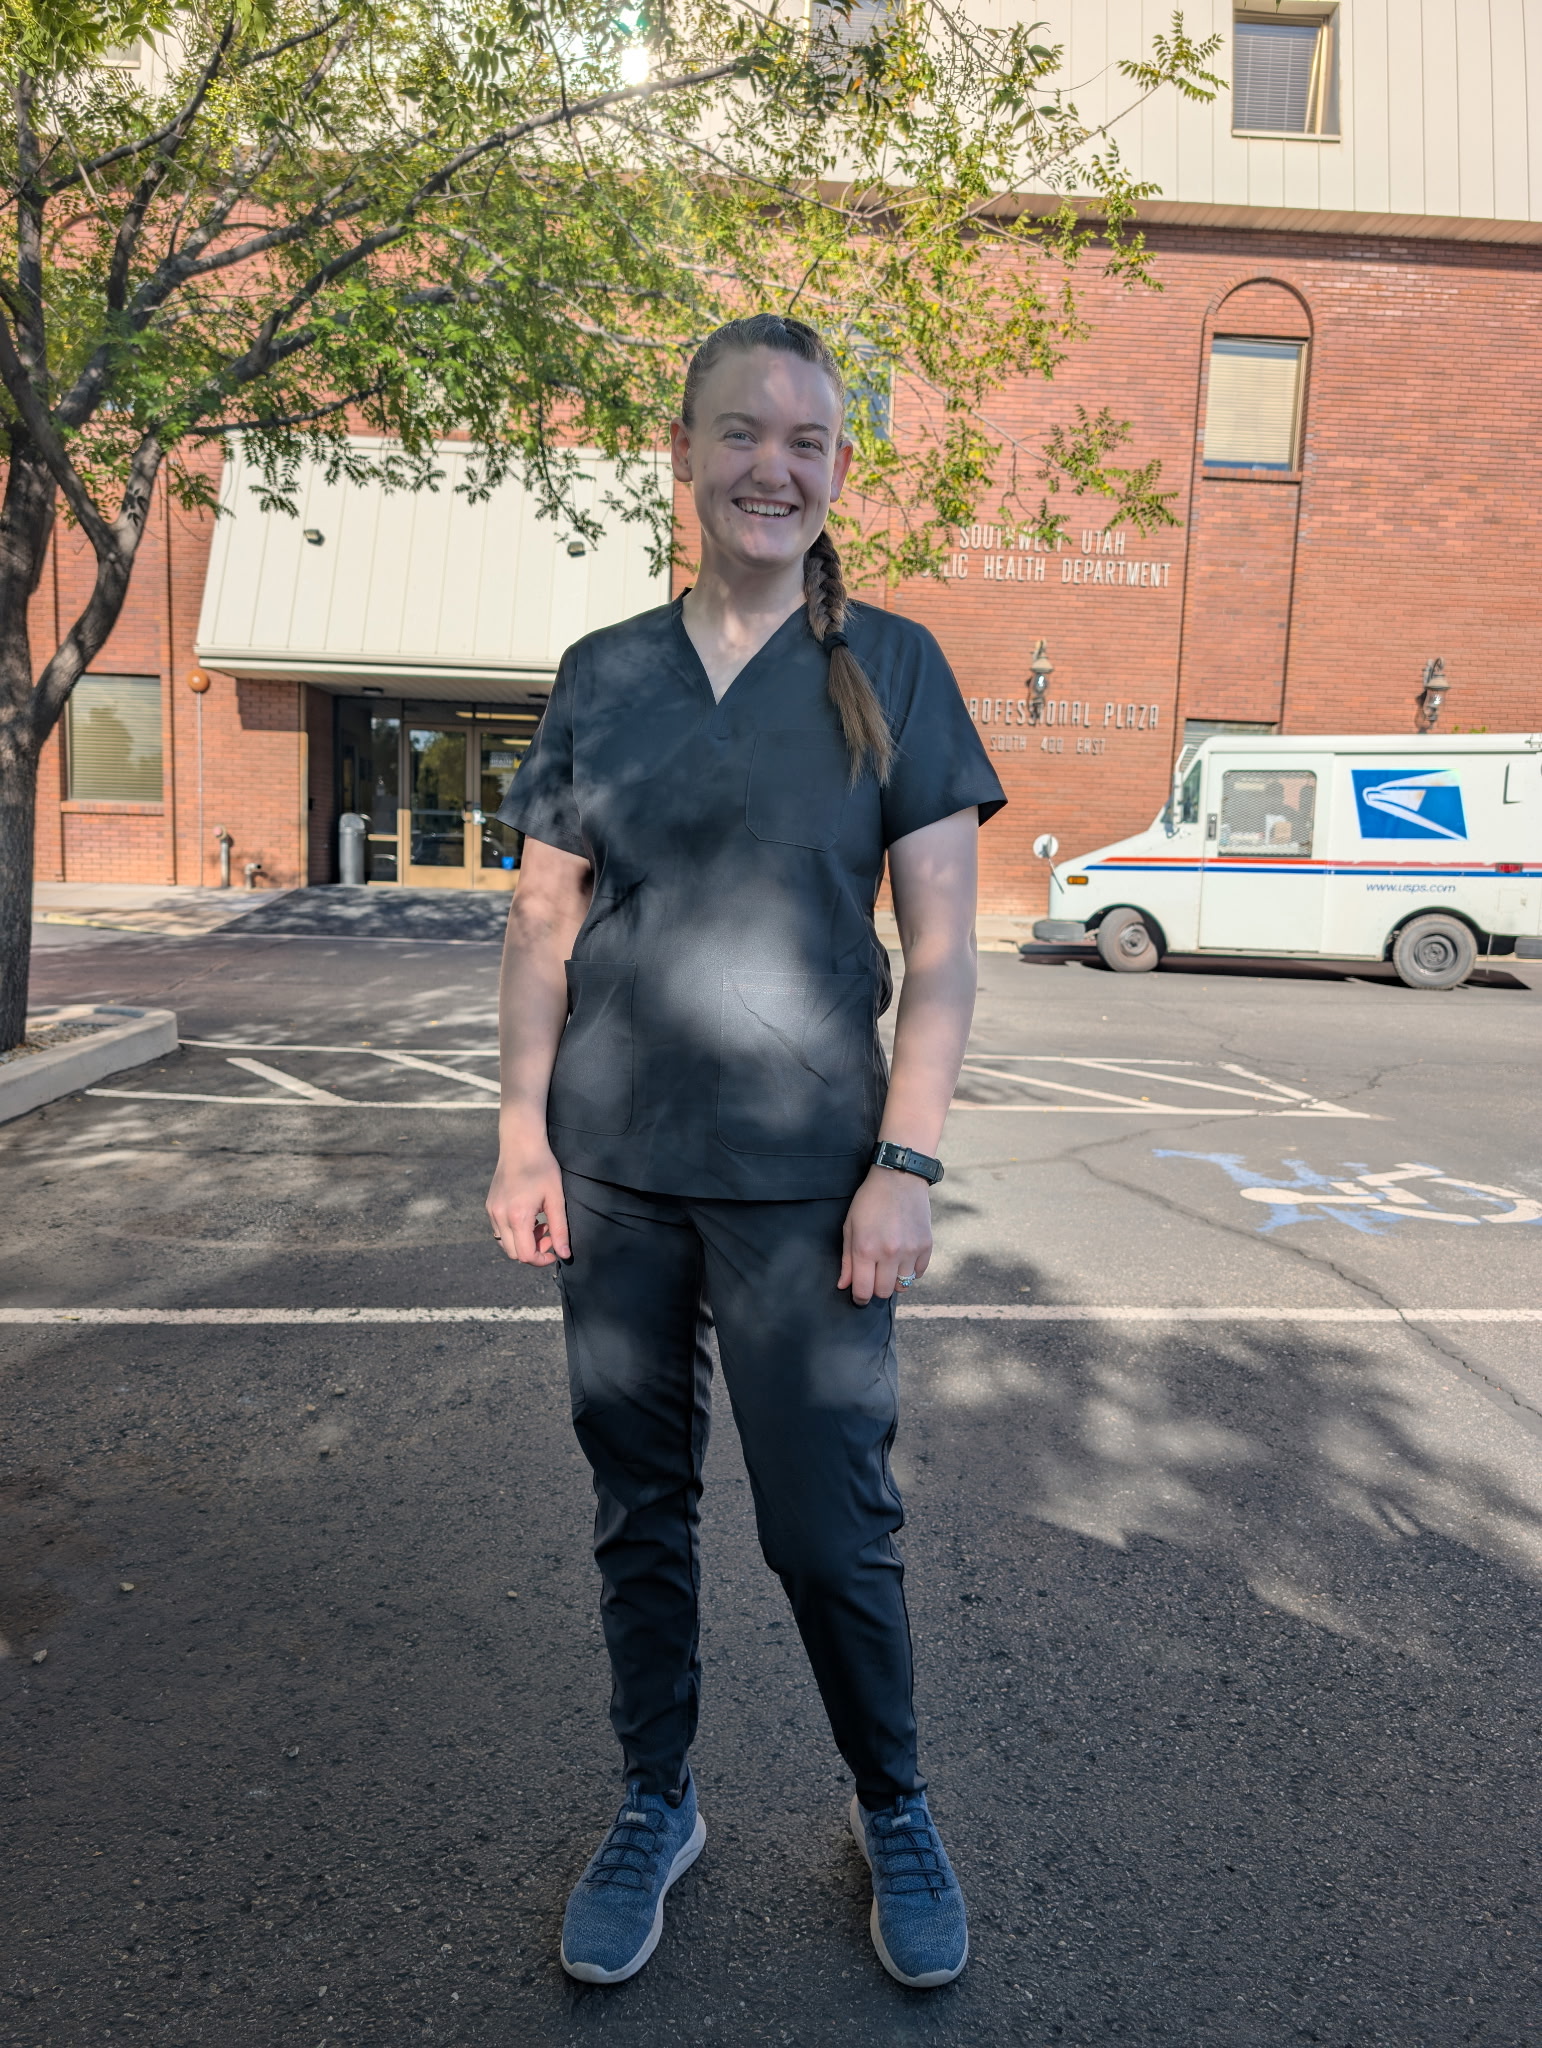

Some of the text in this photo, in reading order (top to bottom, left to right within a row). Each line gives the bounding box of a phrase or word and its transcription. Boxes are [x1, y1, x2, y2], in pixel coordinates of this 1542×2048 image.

[1081, 529, 1126, 555] UTAH
[983, 555, 1046, 582] HEALTH
[1061, 558, 1171, 587] DEPARTMENT
[1103, 702, 1159, 730] PLAZA
[990, 735, 1106, 756] SOUTH 400 EAST
[1366, 883, 1456, 893] www.usps.com
